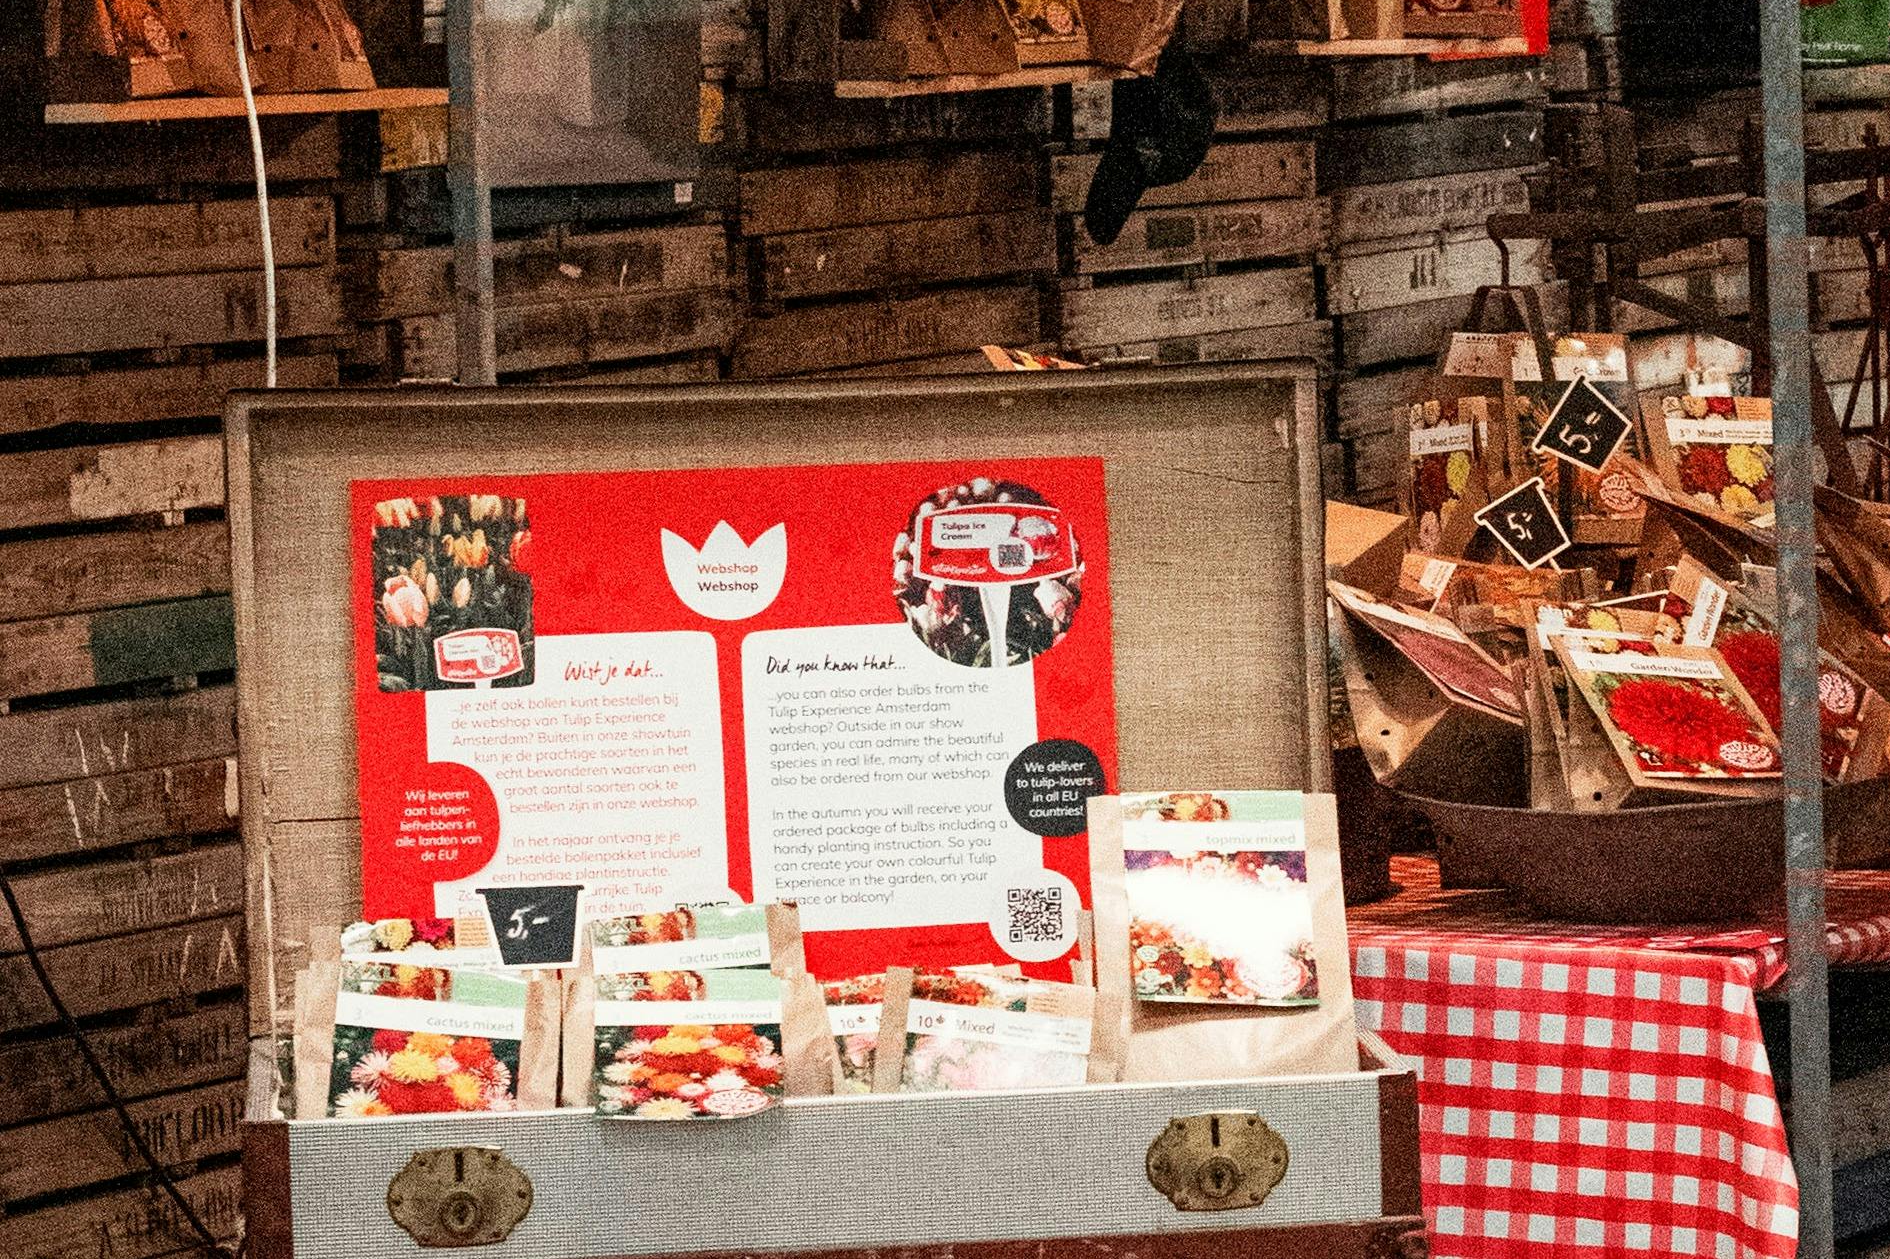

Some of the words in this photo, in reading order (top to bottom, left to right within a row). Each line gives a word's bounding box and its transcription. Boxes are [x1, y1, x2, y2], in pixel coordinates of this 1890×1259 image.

[697, 563, 758, 579] Webshop
[697, 580, 759, 595] Webshop
[767, 656, 789, 674] Did
[796, 661, 818, 678] you
[825, 655, 858, 672] know
[864, 655, 906, 671] that...
[1024, 762, 1044, 772] We
[1047, 760, 1085, 772] deliver
[1017, 779, 1028, 788] to
[1031, 777, 1093, 789] tulip-lovers
[1033, 792, 1043, 802] in
[1046, 791, 1059, 802] all
[1062, 791, 1078, 801] EU
[1029, 806, 1083, 817] countries!
[1256, 833, 1296, 845] mixed
[680, 950, 720, 965] cactus
[722, 946, 761, 962] mixed
[427, 1016, 470, 1031] cactus
[473, 1019, 514, 1033] mixed
[955, 1019, 995, 1036] Mixed
